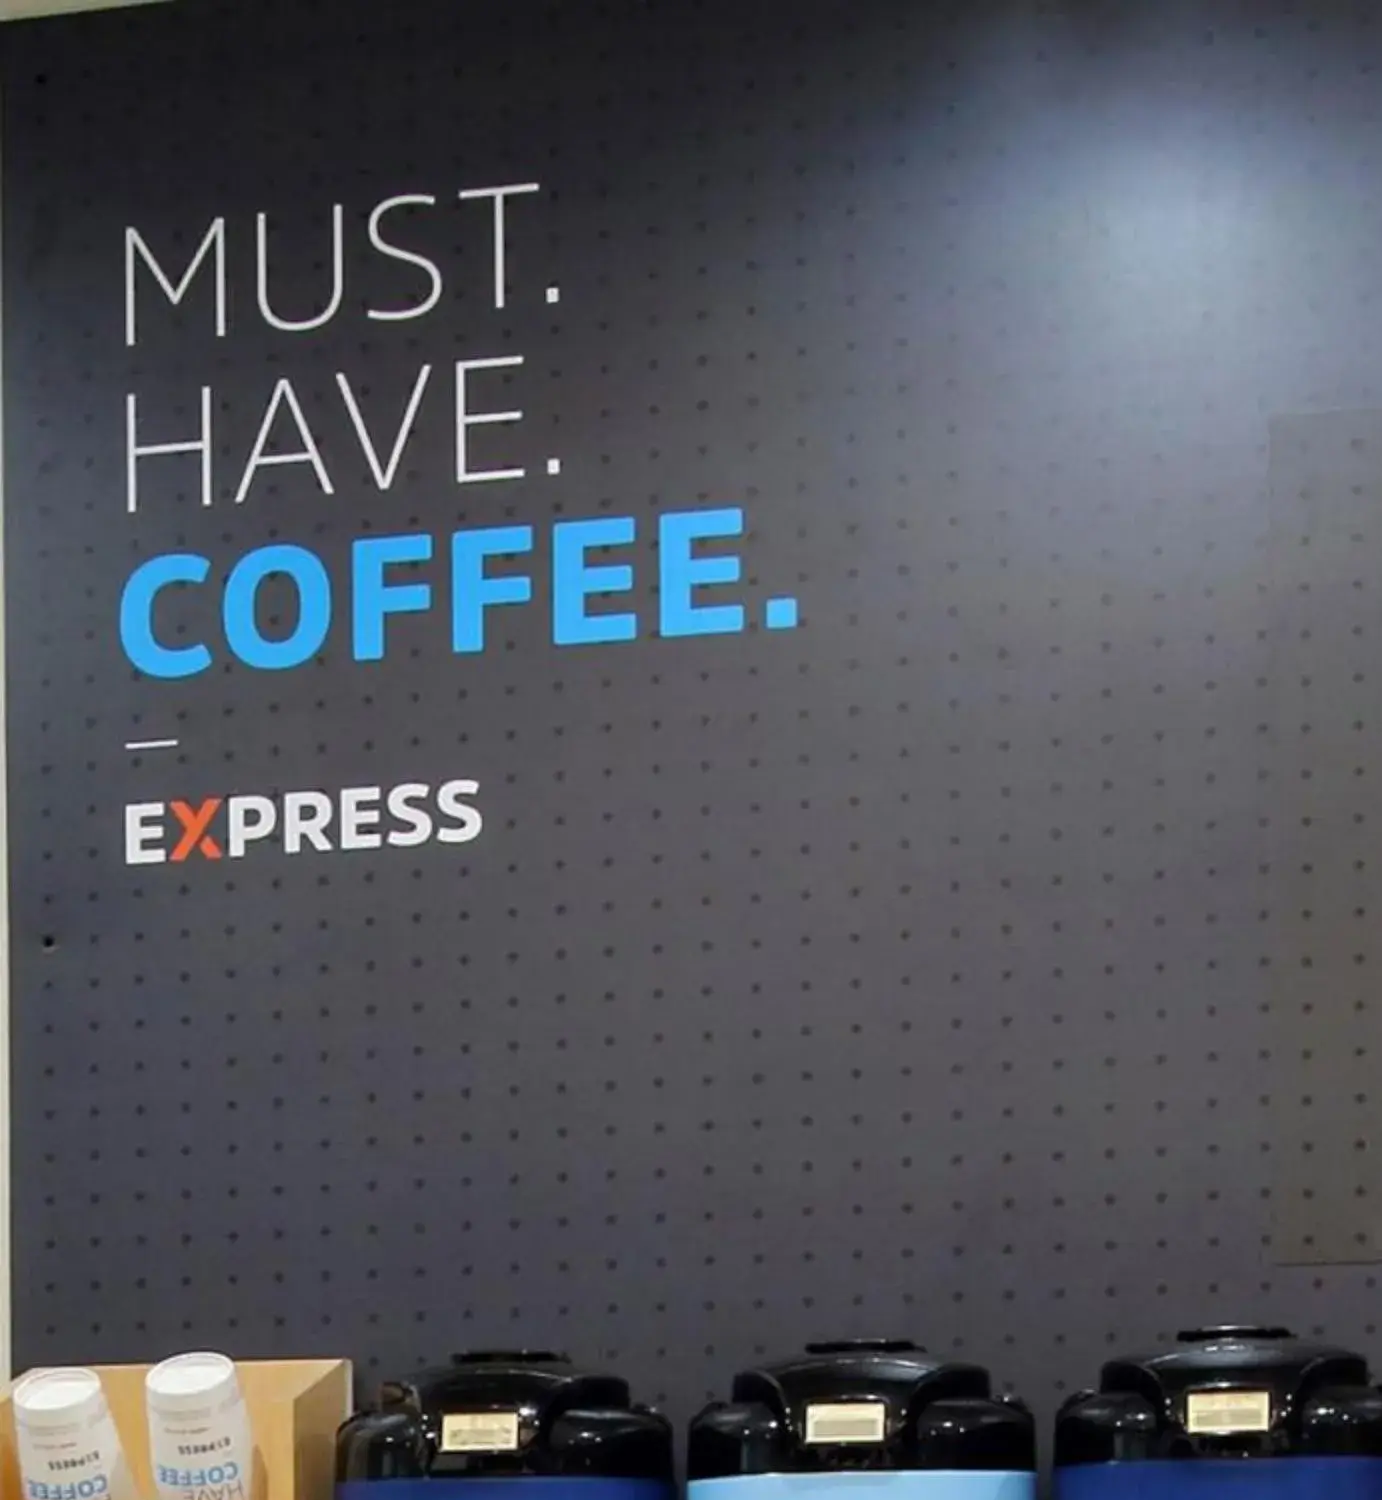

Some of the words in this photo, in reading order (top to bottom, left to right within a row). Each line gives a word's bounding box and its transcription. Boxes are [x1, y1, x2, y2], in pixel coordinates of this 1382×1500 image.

[125, 183, 560, 346] MUST.
[126, 355, 560, 512] HAVE.
[119, 507, 797, 679] COFFEE.
[124, 779, 483, 865] EXPRESS
